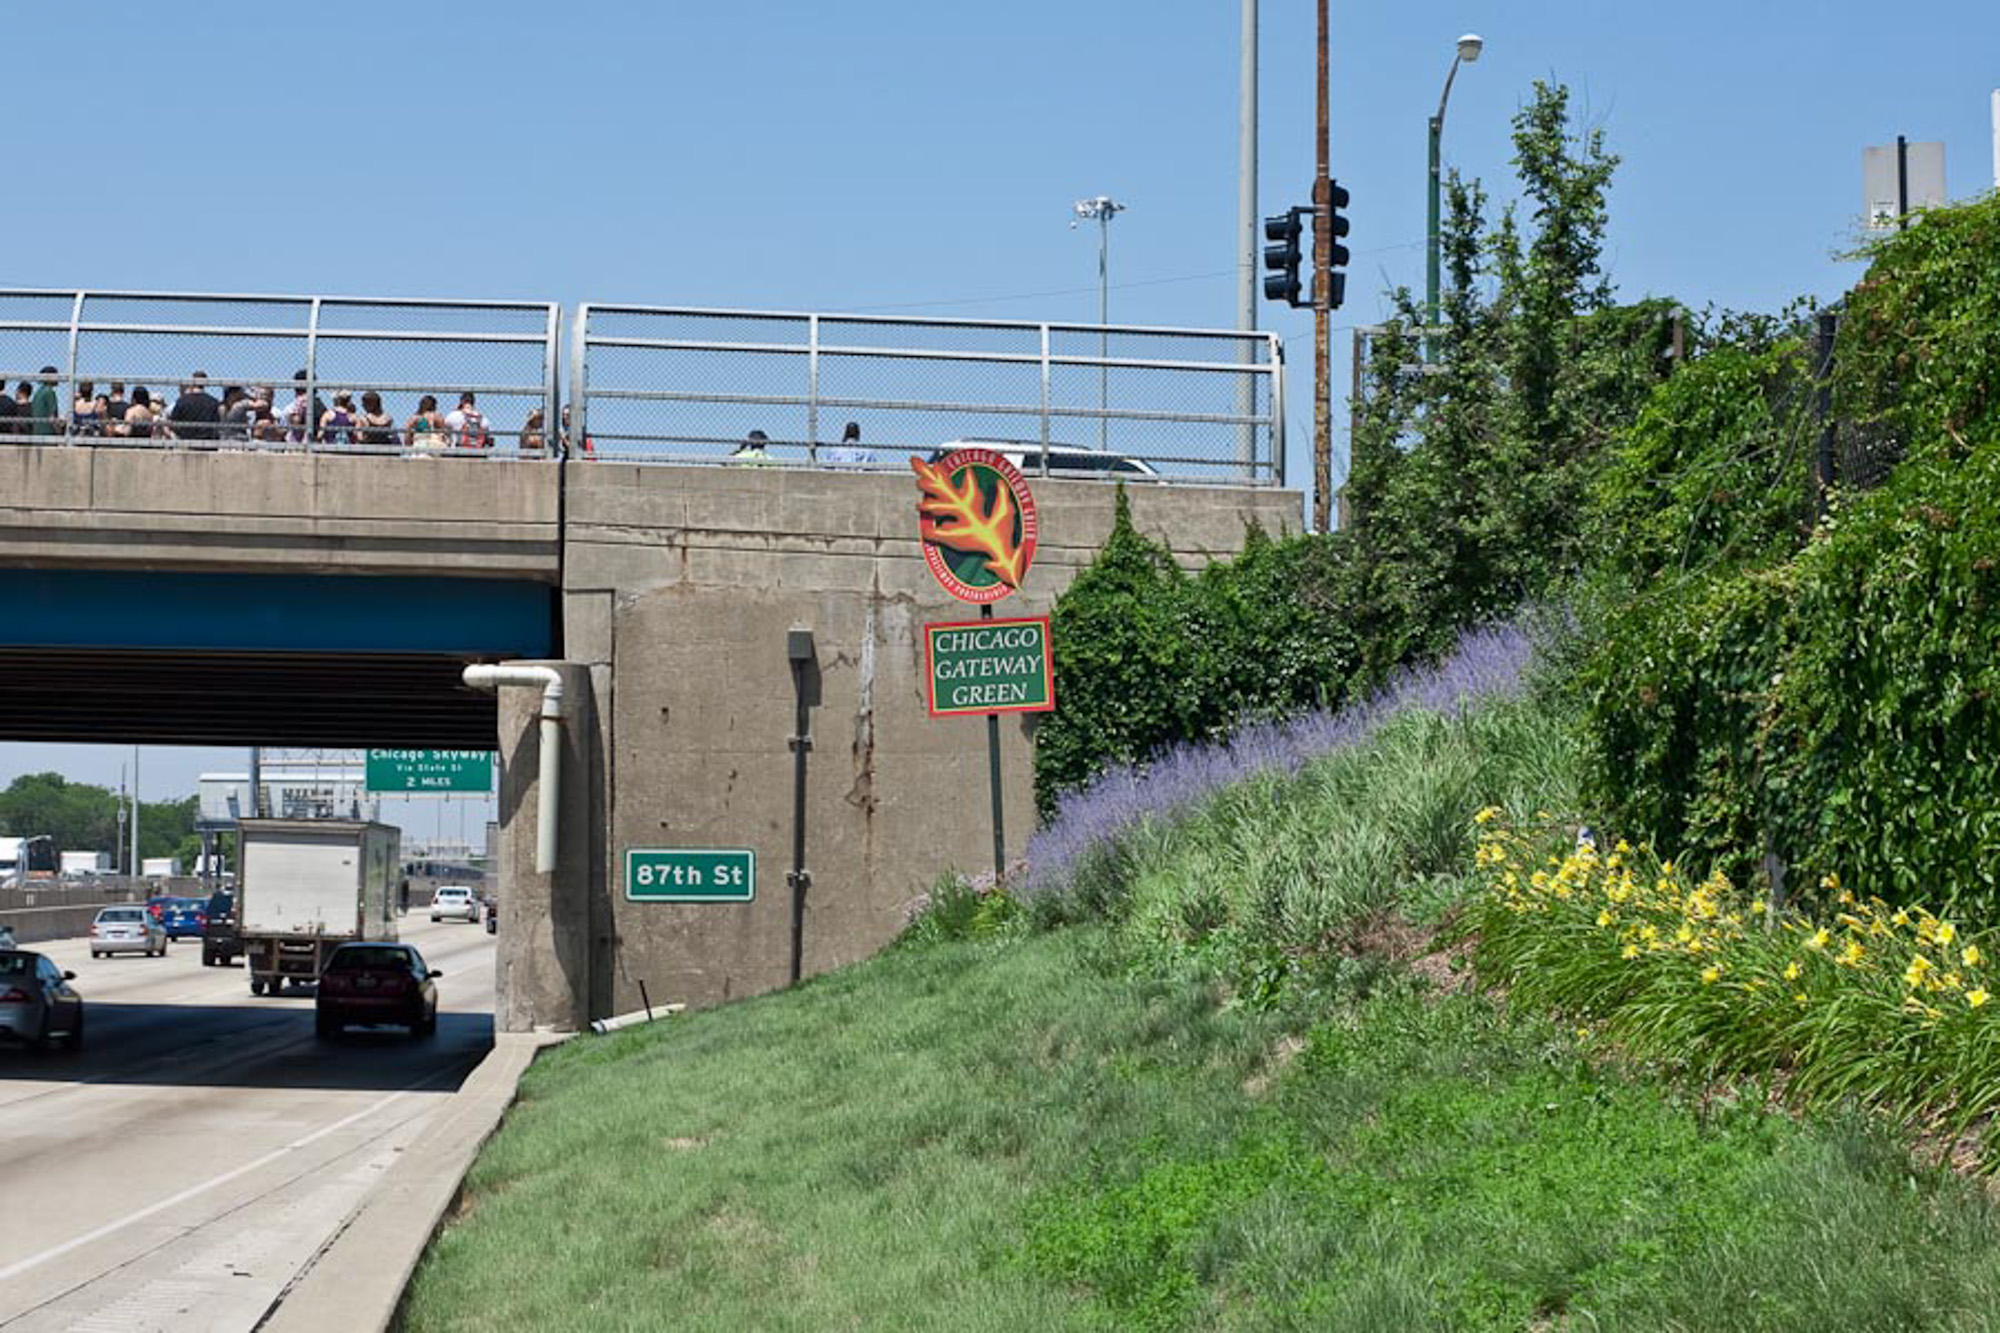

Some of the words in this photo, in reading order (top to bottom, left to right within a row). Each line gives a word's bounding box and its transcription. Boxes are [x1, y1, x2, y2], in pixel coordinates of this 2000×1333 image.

[936, 628, 1038, 652] CHICAGO
[936, 655, 1041, 679] GATEWAY
[952, 682, 1027, 705] GREEN
[406, 777, 416, 788] 2
[421, 777, 451, 787] MILES
[637, 864, 702, 886] 87th
[713, 865, 743, 886] St
